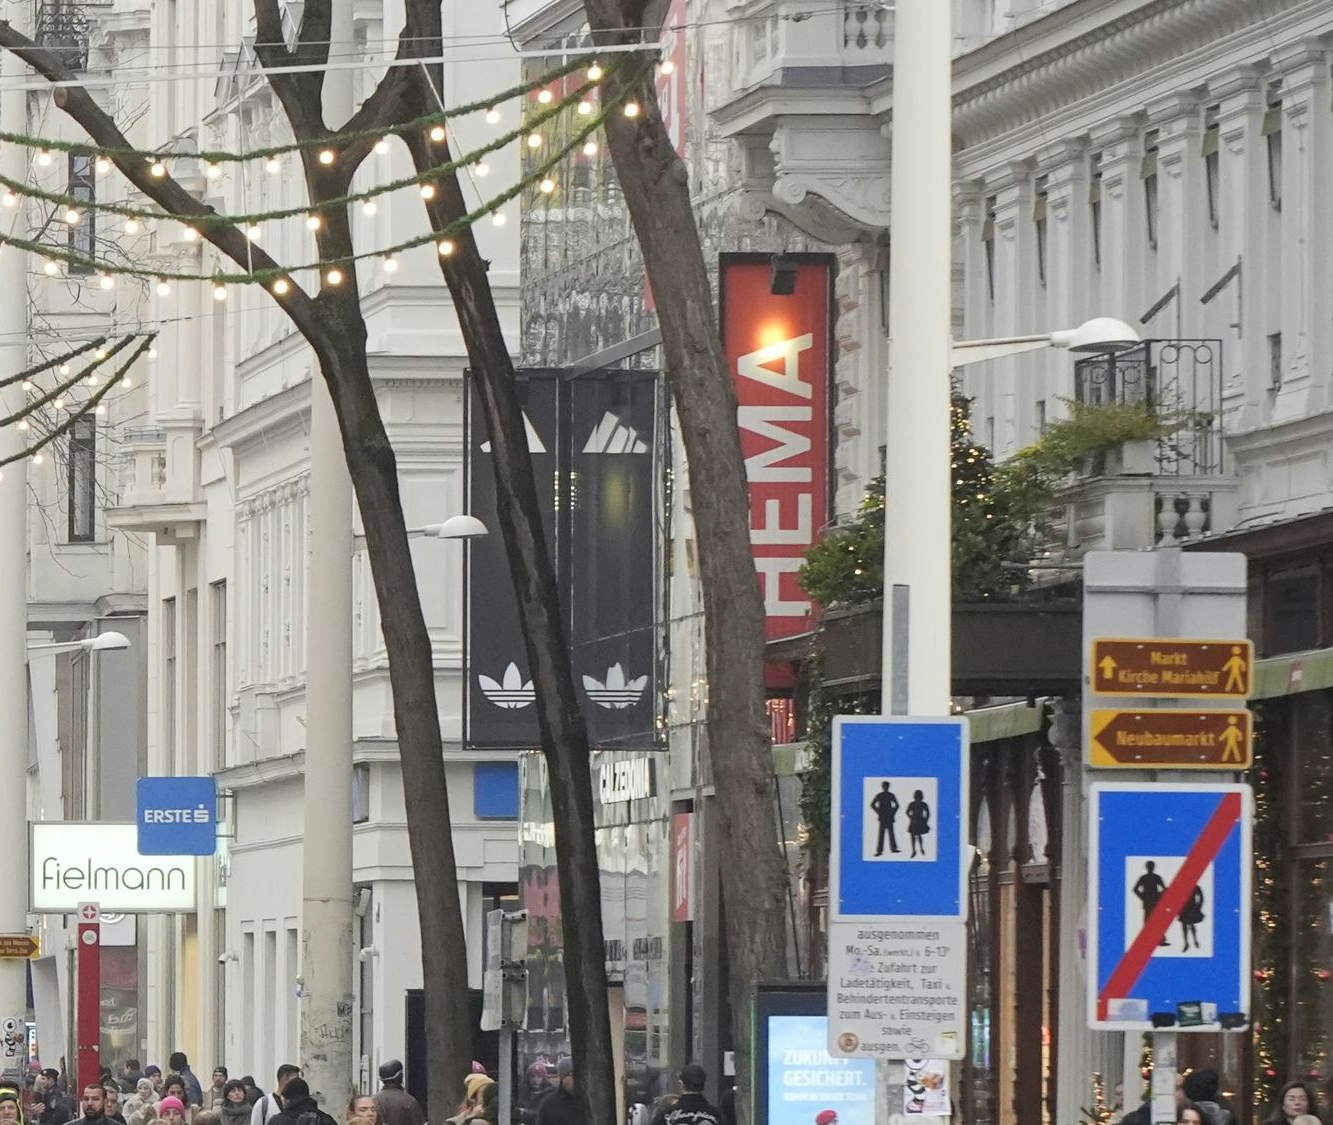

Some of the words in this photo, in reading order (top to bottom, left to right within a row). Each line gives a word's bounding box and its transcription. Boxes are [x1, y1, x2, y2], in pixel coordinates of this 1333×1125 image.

[737, 332, 813, 617] HEMA
[1150, 651, 1187, 666] Markt
[144, 810, 192, 823] ERSTE
[43, 857, 185, 890] fielmann
[857, 930, 940, 942] ausgenommen
[878, 962, 918, 974] Zufahrt
[921, 979, 943, 990] Taxi
[836, 993, 958, 1006] Behindertentransporte
[783, 1070, 868, 1087] GESICHERT.
